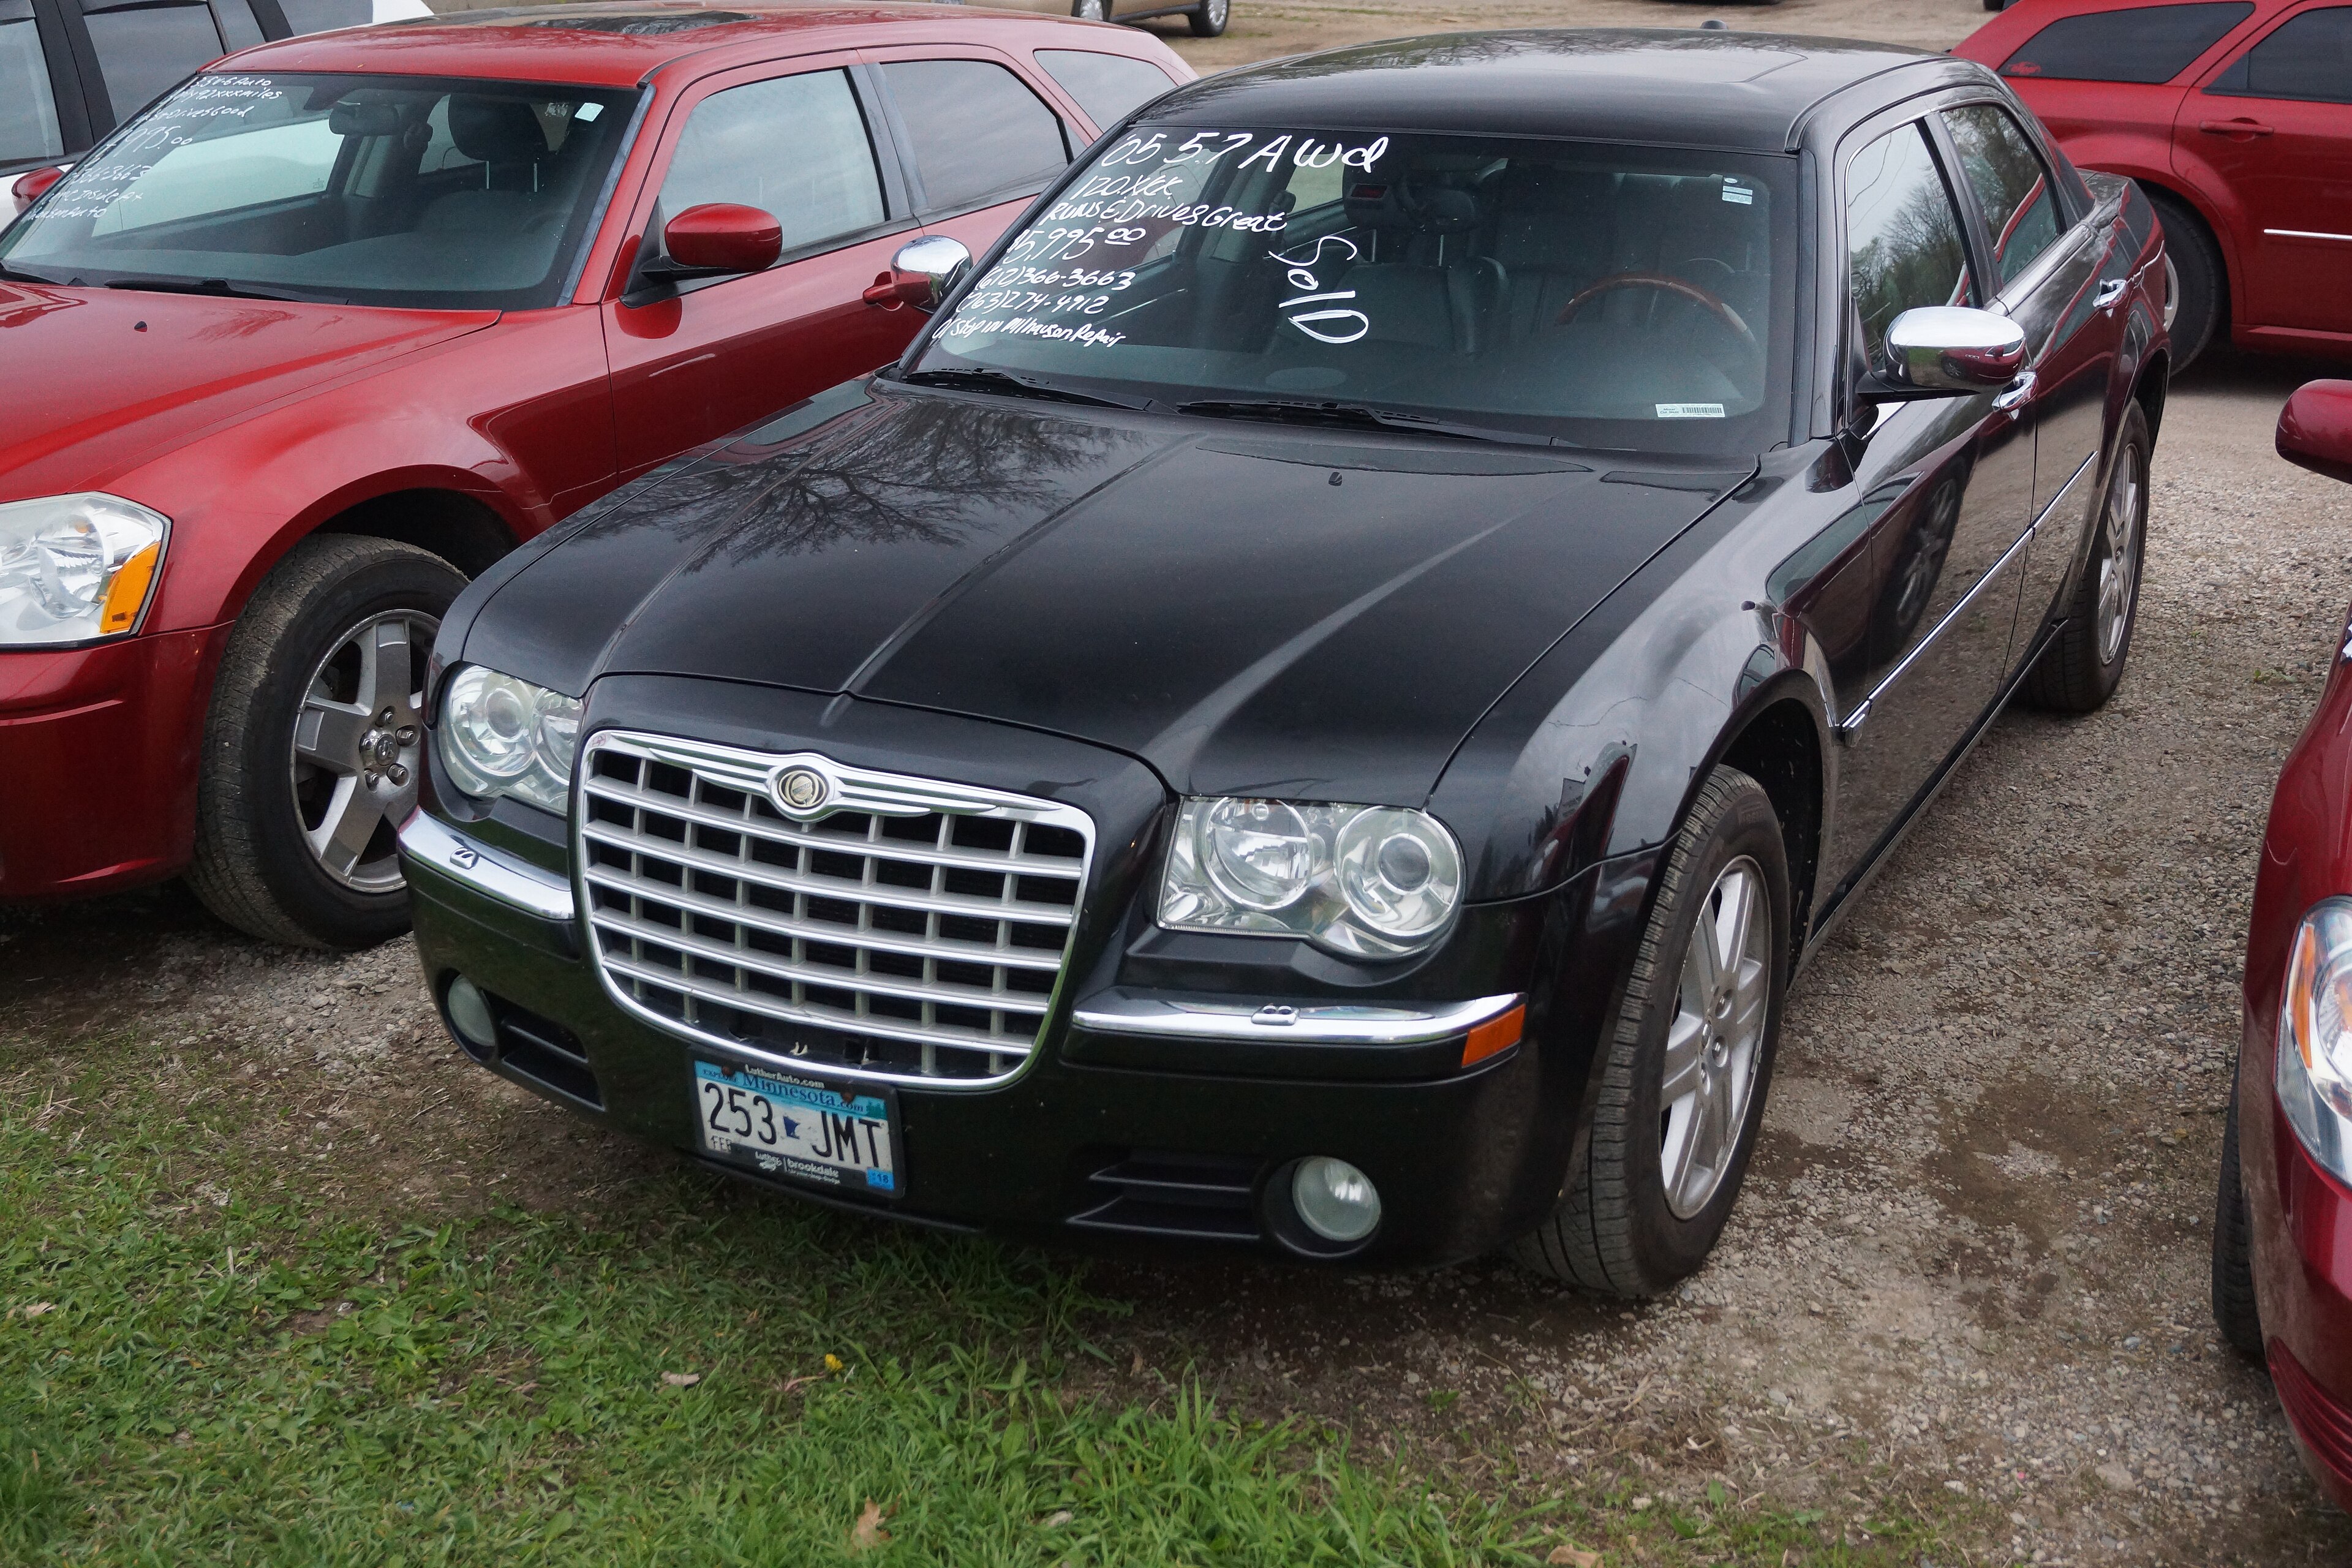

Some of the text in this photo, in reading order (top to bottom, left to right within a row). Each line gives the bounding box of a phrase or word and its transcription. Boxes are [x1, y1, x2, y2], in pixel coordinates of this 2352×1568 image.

[1163, 132, 1253, 165] 5.7
[1201, 206, 1287, 233] Great
[704, 1082, 881, 1168] 253 JMT
